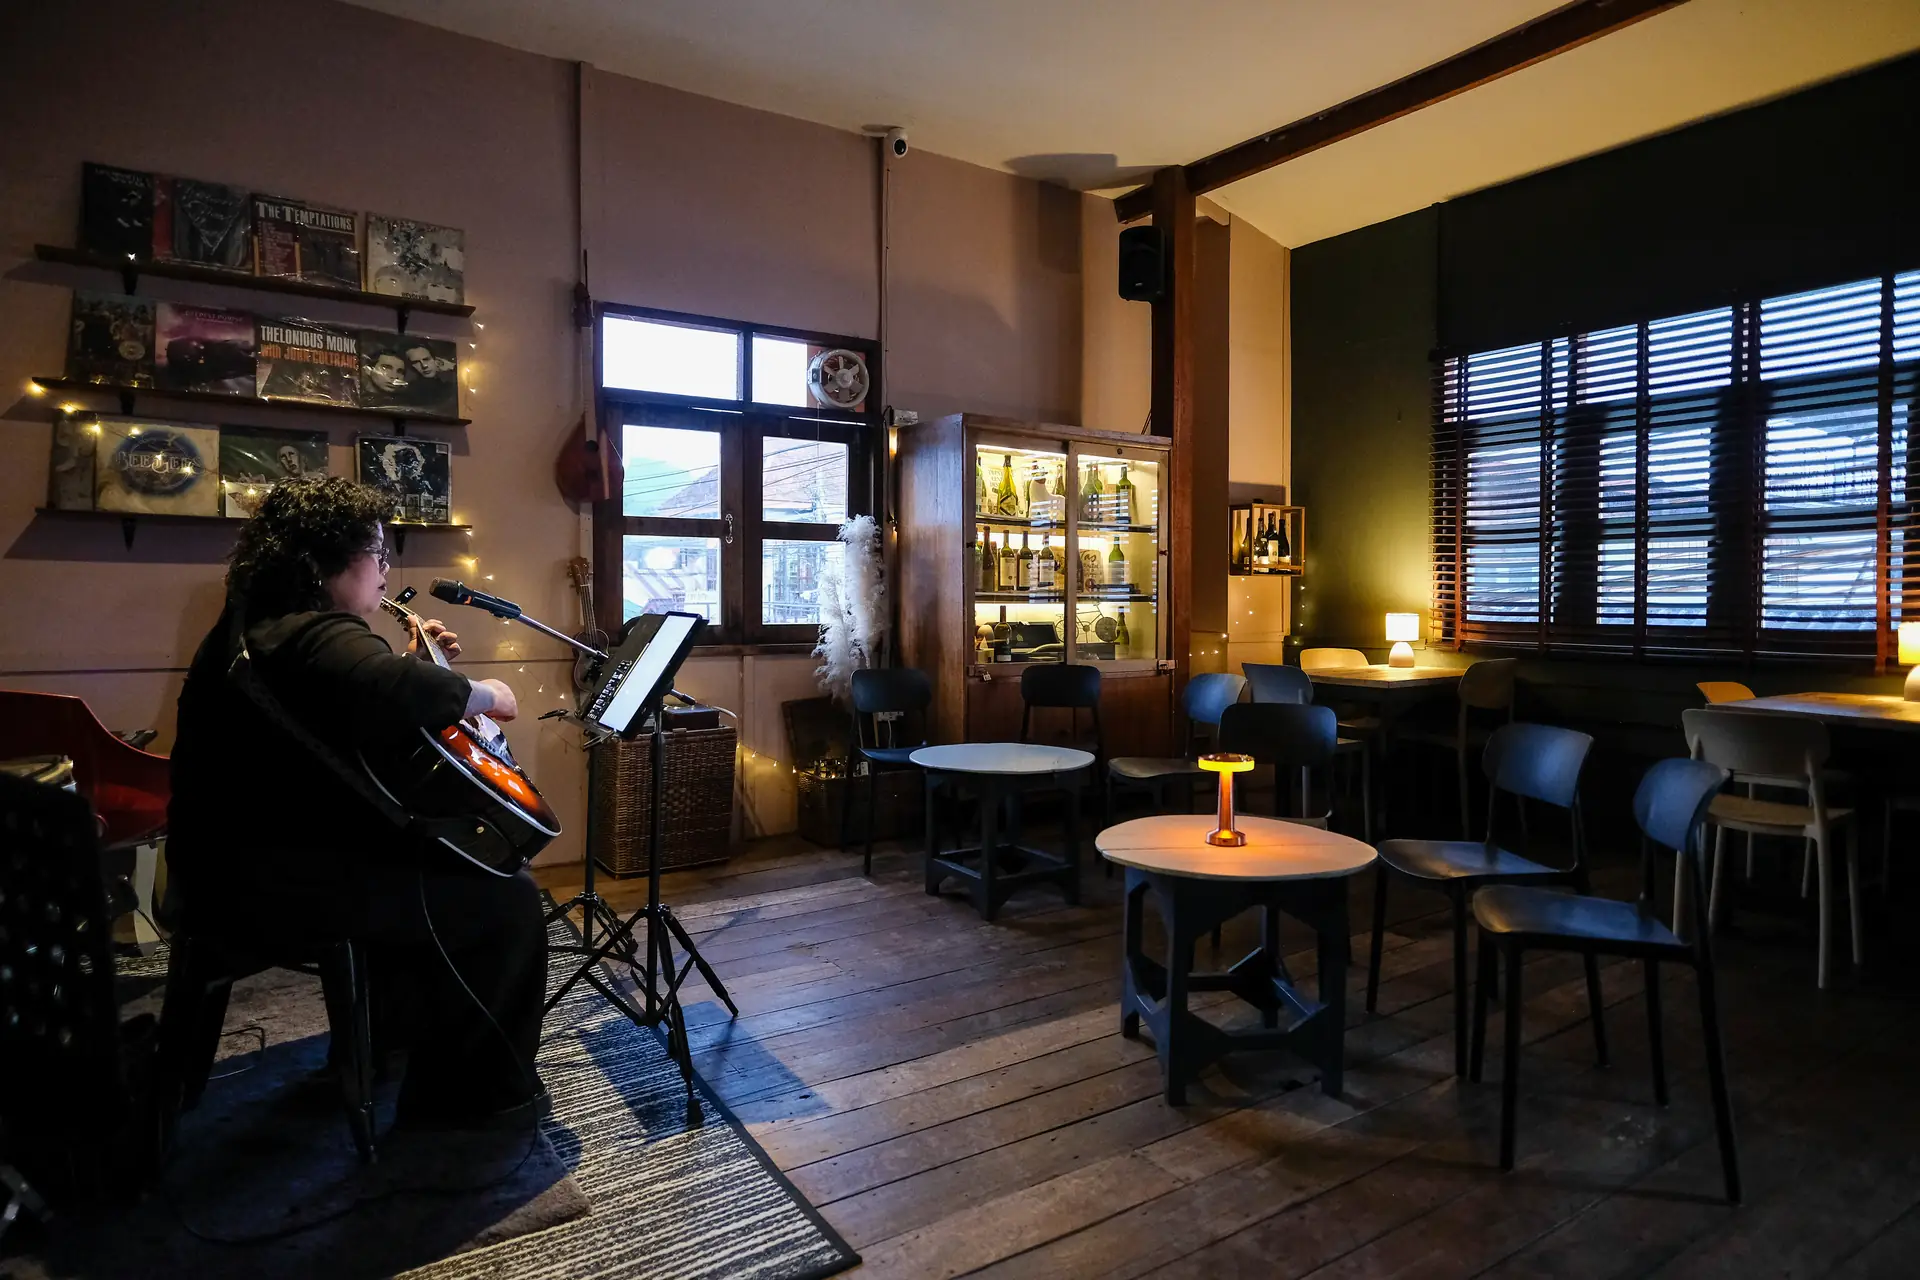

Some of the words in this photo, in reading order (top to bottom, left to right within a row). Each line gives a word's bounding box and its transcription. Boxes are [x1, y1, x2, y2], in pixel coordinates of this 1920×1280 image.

[256, 201, 281, 219] THE
[283, 205, 353, 232] TEMPTATIONS
[260, 325, 324, 349] THELONIOUS
[326, 335, 357, 354] MONK
[312, 349, 358, 369] COLTRANE
